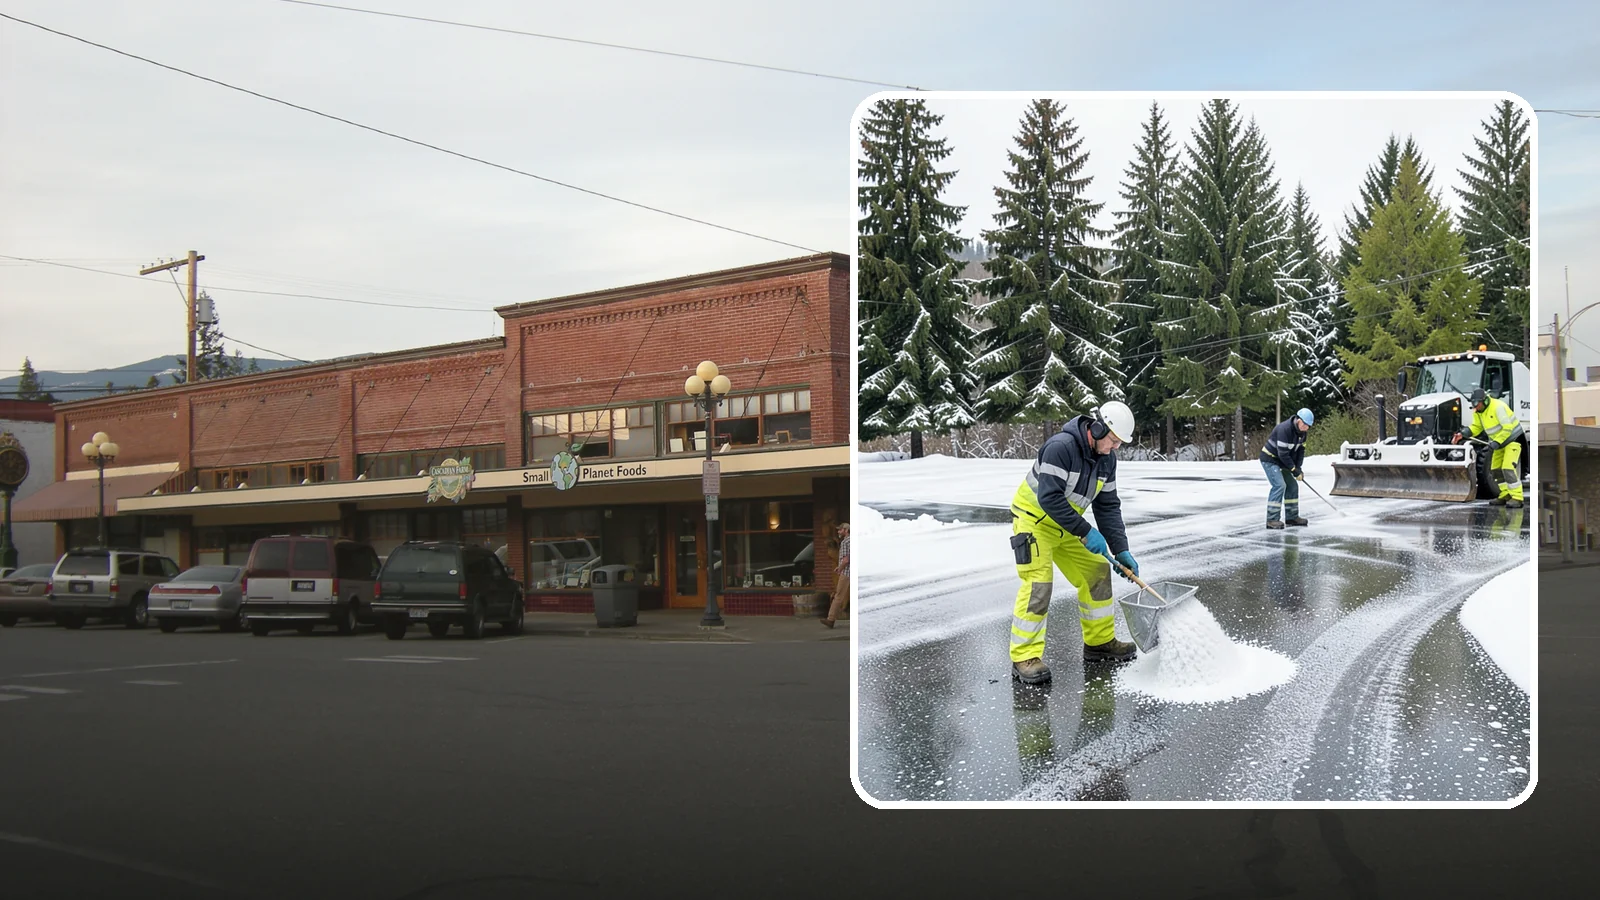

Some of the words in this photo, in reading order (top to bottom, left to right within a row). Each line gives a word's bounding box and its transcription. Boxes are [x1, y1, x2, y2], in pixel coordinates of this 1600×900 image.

[523, 471, 549, 483] Small
[583, 468, 614, 479] Planet
[617, 464, 647, 476] Foods
